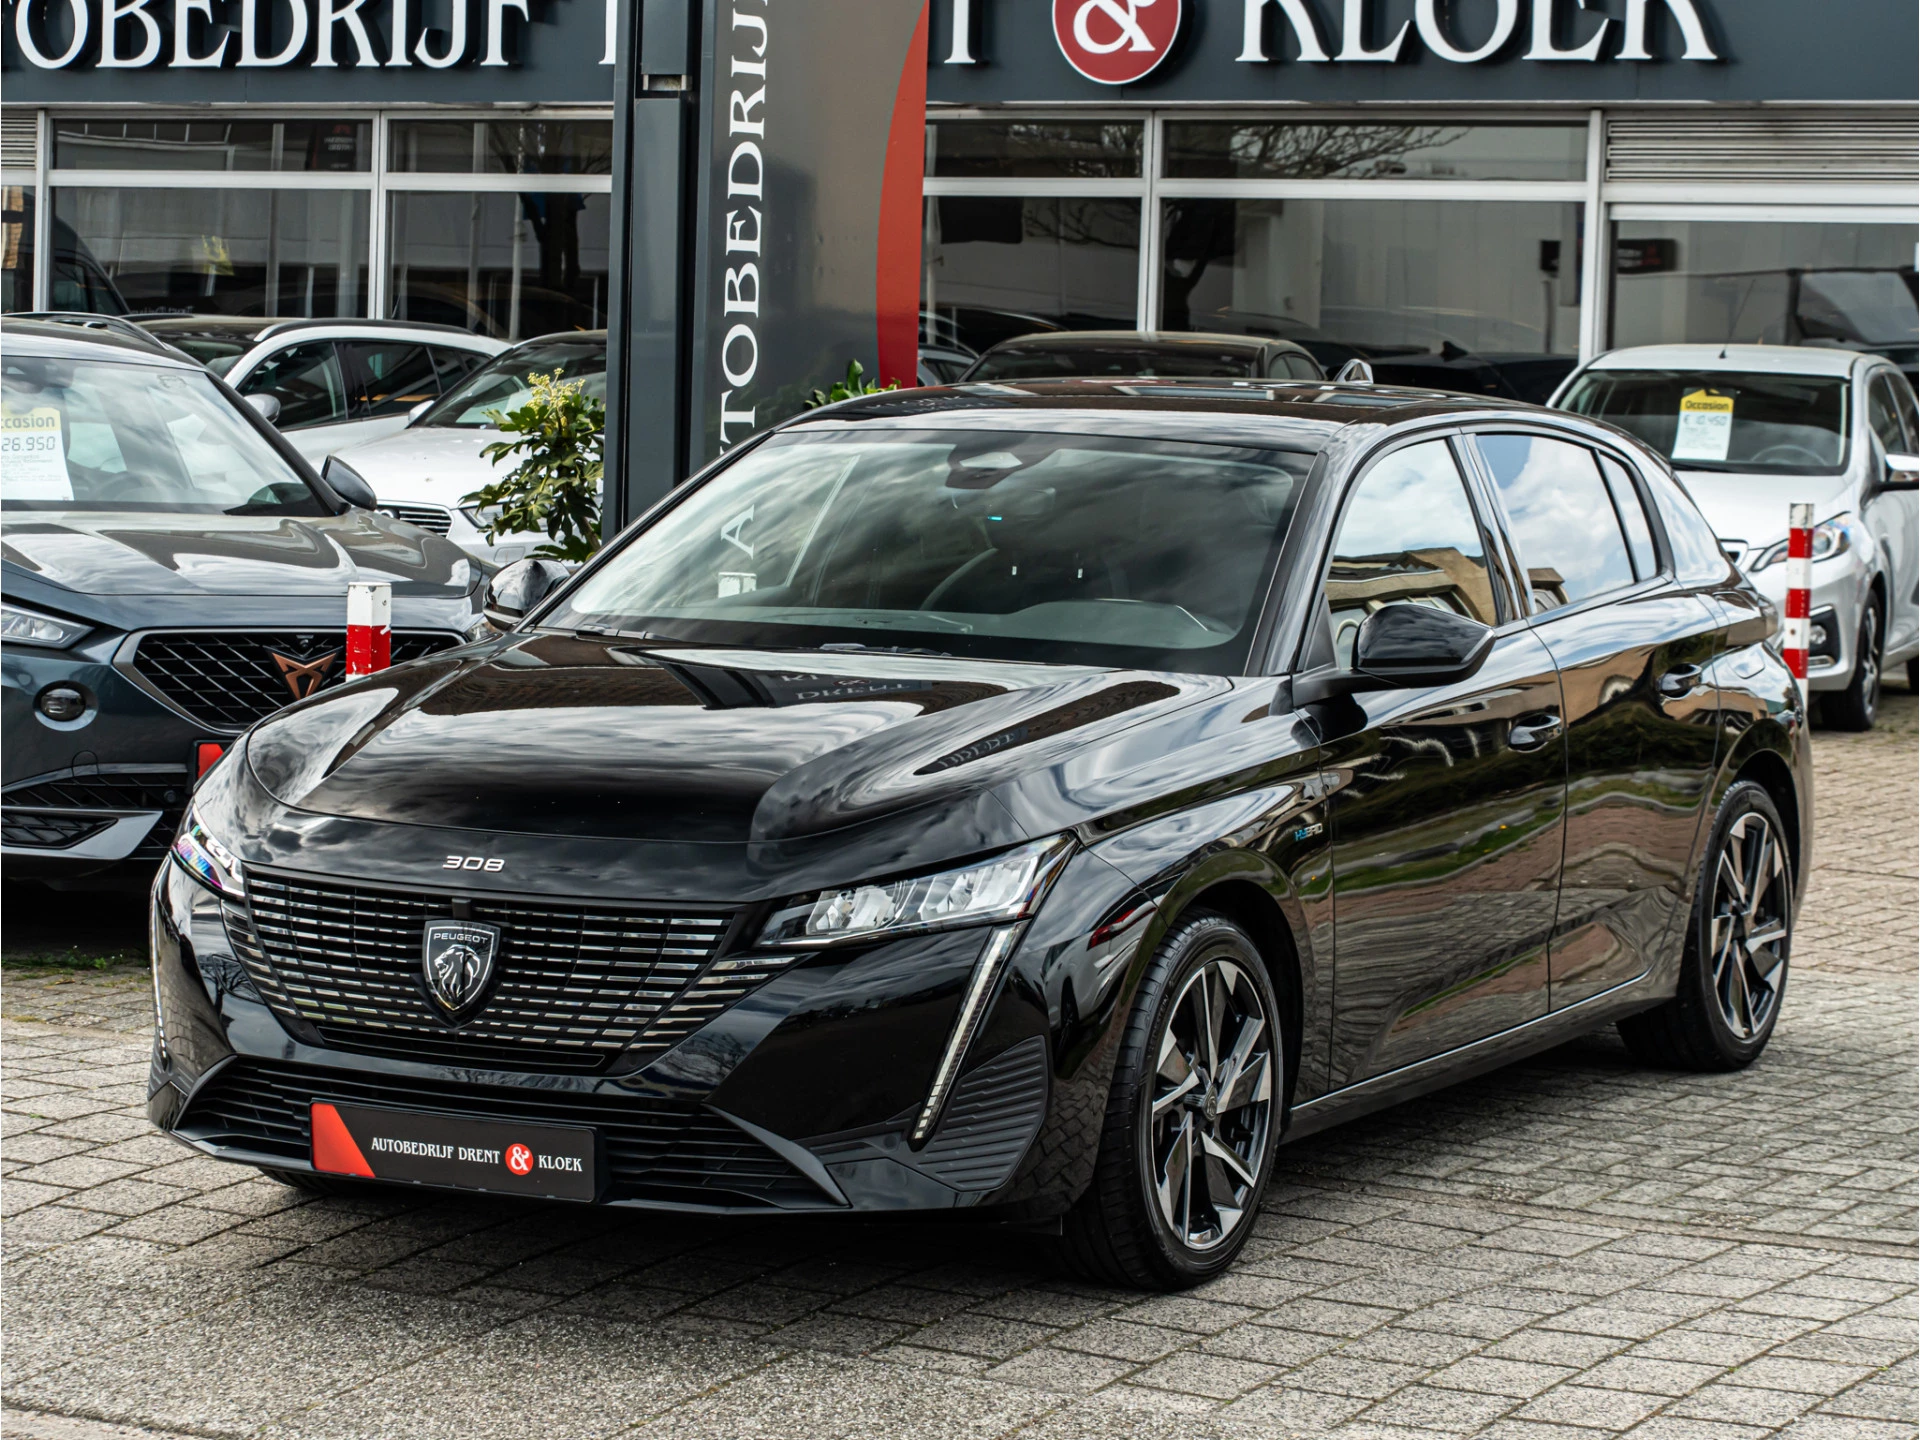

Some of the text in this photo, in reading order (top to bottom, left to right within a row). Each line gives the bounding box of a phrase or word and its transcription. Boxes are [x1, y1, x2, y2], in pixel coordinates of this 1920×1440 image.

[8, 0, 529, 69] OBEDRIJF
[1684, 400, 1729, 411] Occasion
[1, 435, 56, 452] 26.950
[1294, 823, 1323, 842] HYBRID
[442, 855, 505, 872] 308
[432, 932, 488, 945] PEUGEOT
[371, 1136, 583, 1172] AUTOBEDRIJF DRENT & KLOEK
